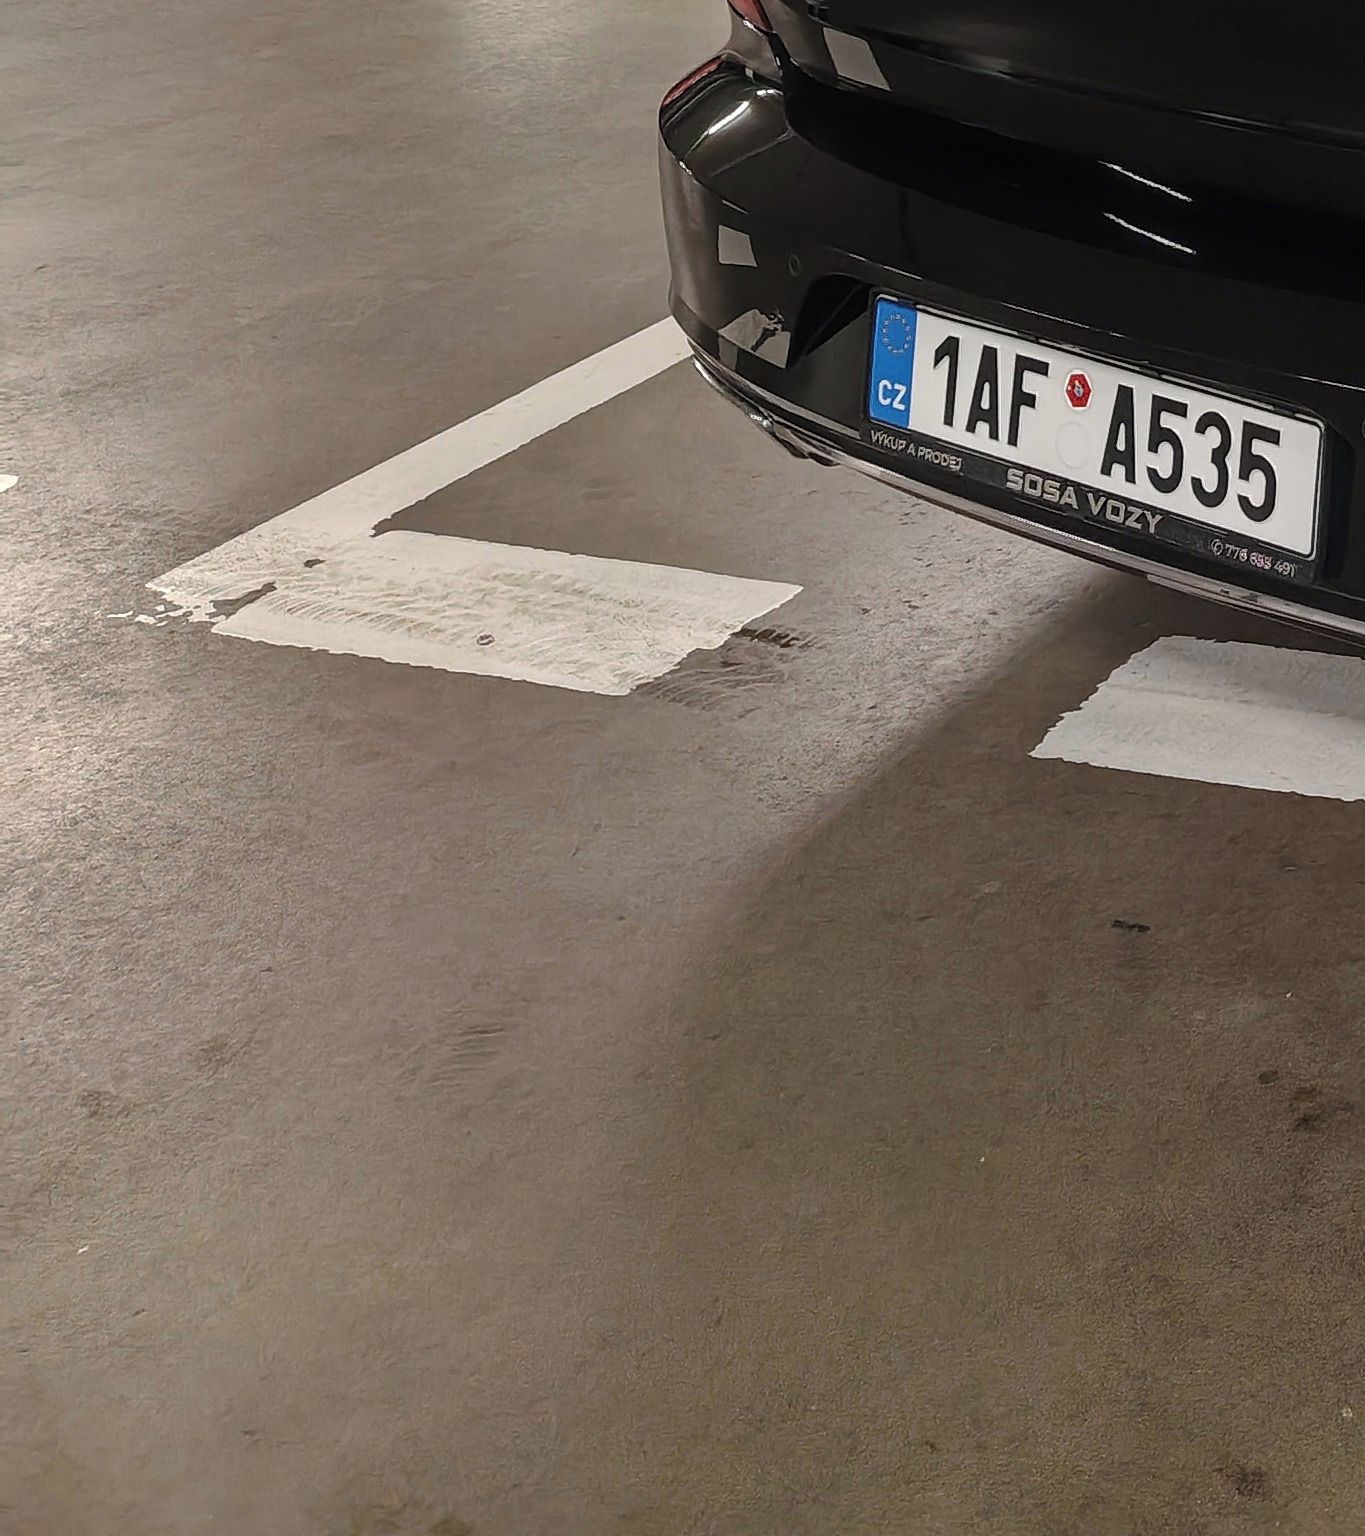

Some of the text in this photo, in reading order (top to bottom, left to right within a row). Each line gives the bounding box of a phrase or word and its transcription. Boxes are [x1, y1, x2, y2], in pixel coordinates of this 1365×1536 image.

[878, 379, 907, 411] CZ
[932, 335, 1281, 523] 1AF A535
[1006, 468, 1166, 534] SOSA VOZY
